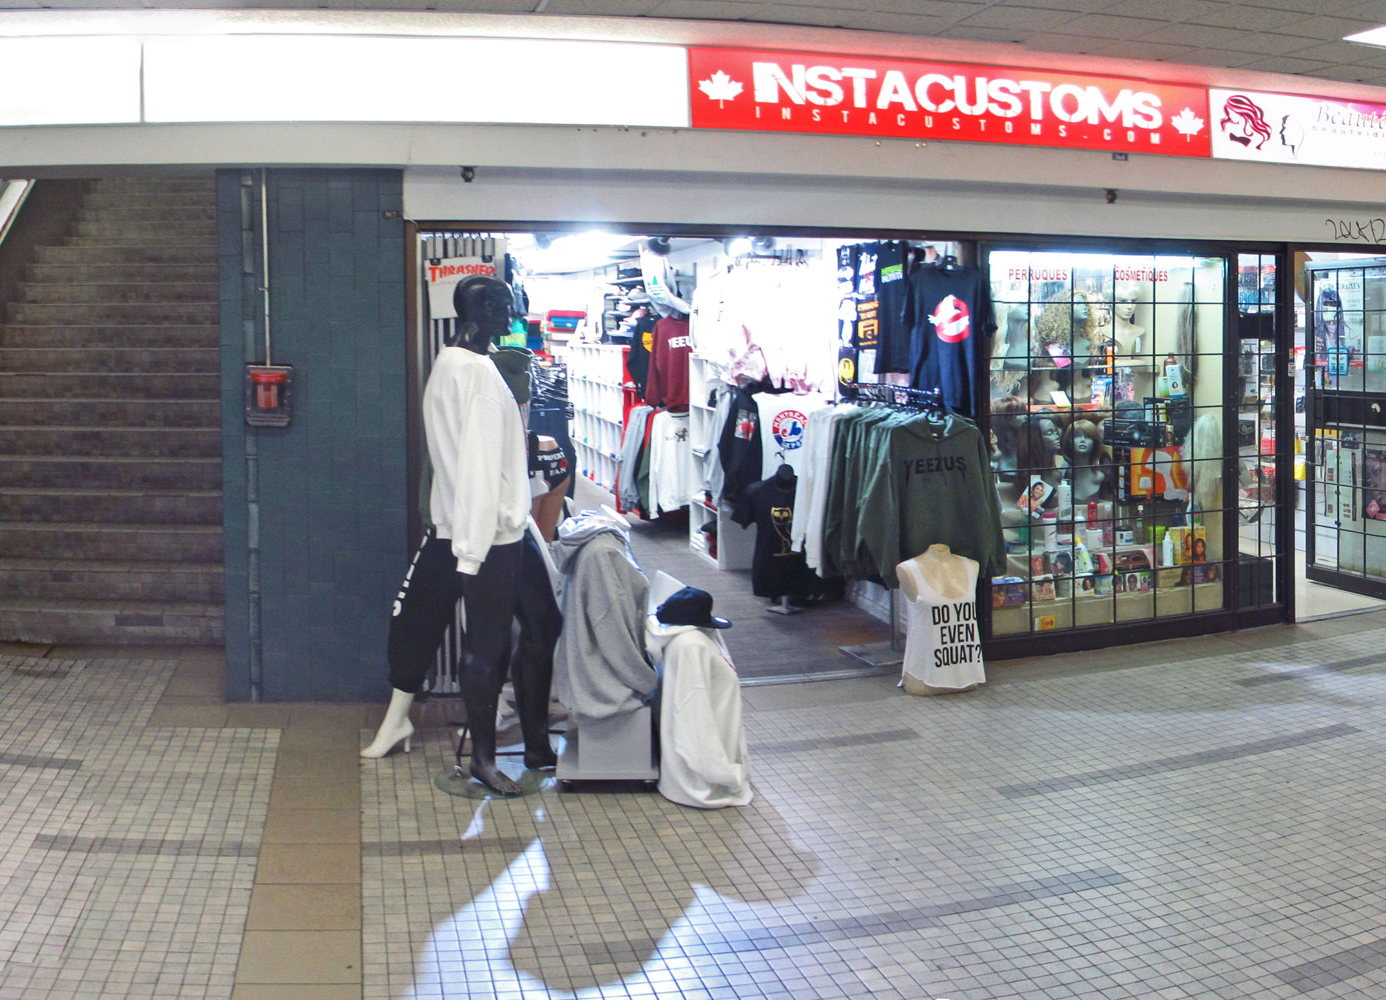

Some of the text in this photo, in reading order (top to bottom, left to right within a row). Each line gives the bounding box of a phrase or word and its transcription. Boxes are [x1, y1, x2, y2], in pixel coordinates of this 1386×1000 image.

[752, 61, 1164, 130] INSTACUSTOMS
[754, 105, 1162, 145] INSTACUSTOMS.COM
[1009, 269, 1068, 281] PERRUQUES
[902, 456, 968, 478] YEEZUS
[931, 604, 950, 626] DO
[940, 623, 975, 645] EVEN
[934, 644, 983, 668] SQUAT?
